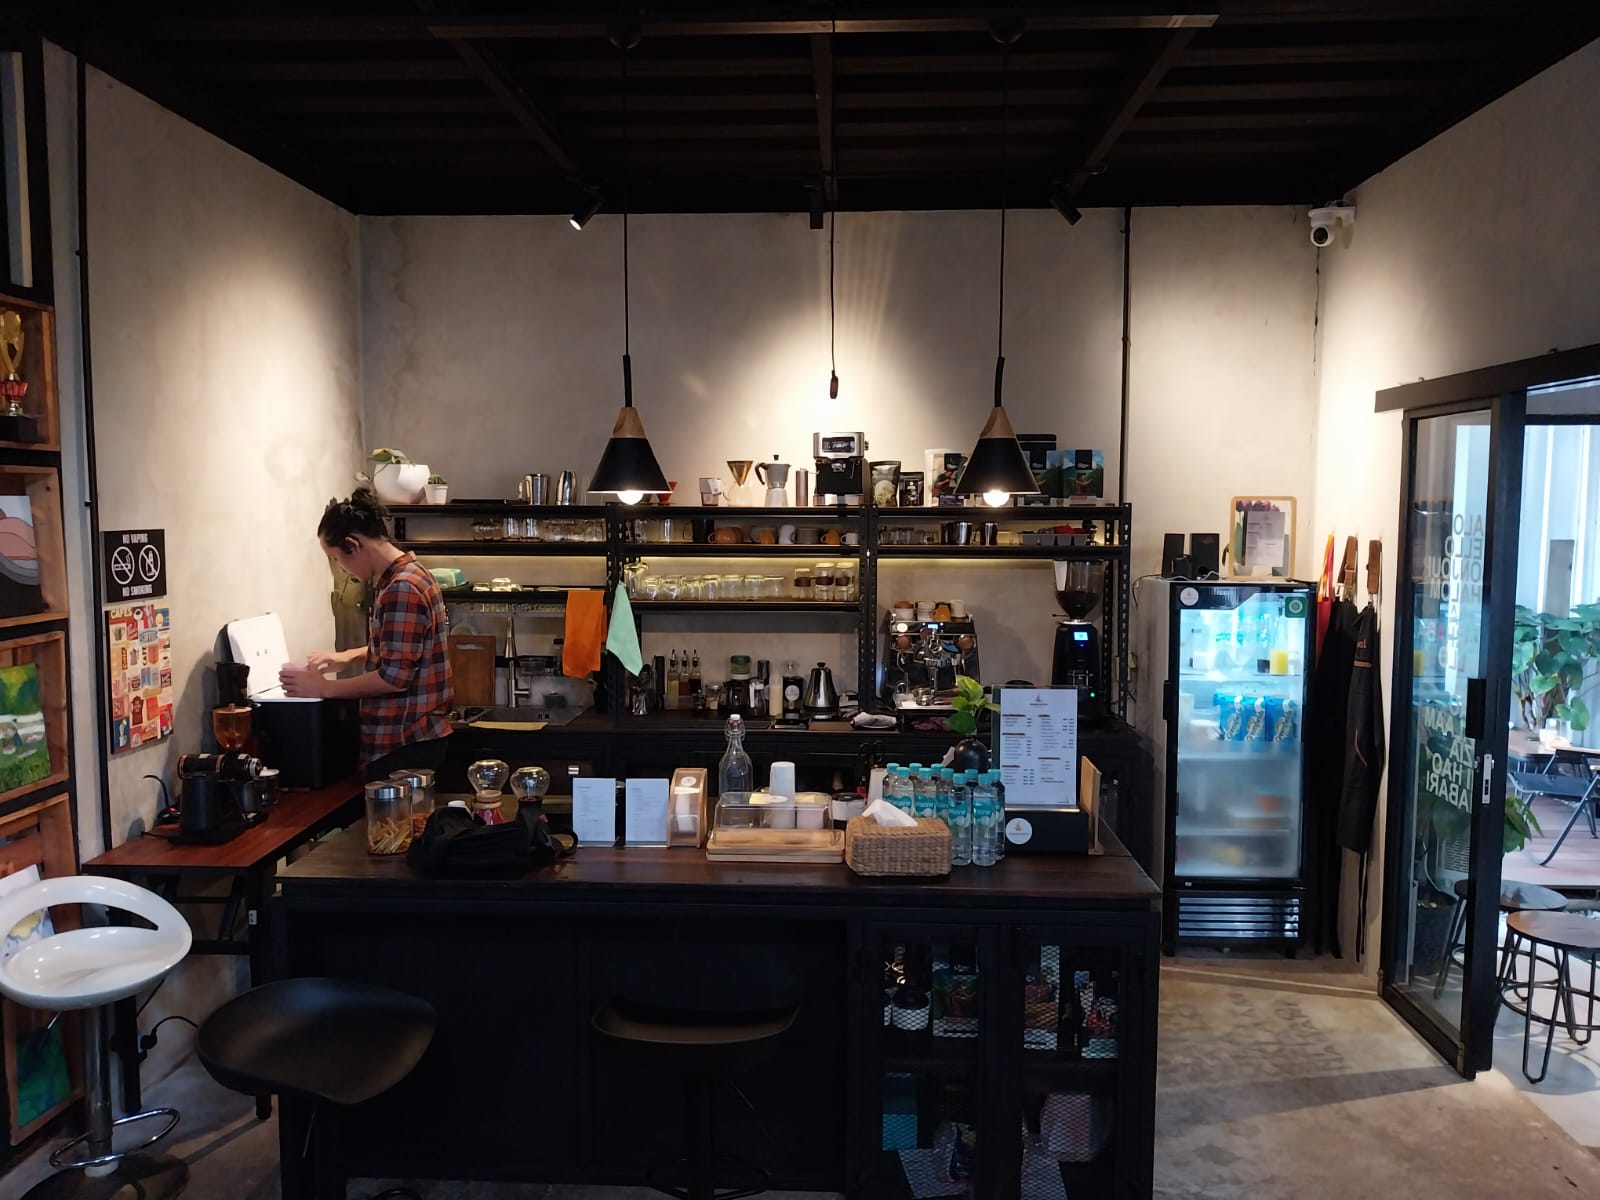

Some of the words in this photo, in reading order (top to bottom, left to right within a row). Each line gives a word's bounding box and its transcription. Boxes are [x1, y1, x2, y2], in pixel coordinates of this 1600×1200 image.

[122, 533, 130, 544] NO
[131, 532, 148, 543] VAPING
[122, 586, 130, 597] NO
[131, 583, 153, 596] SMOKING
